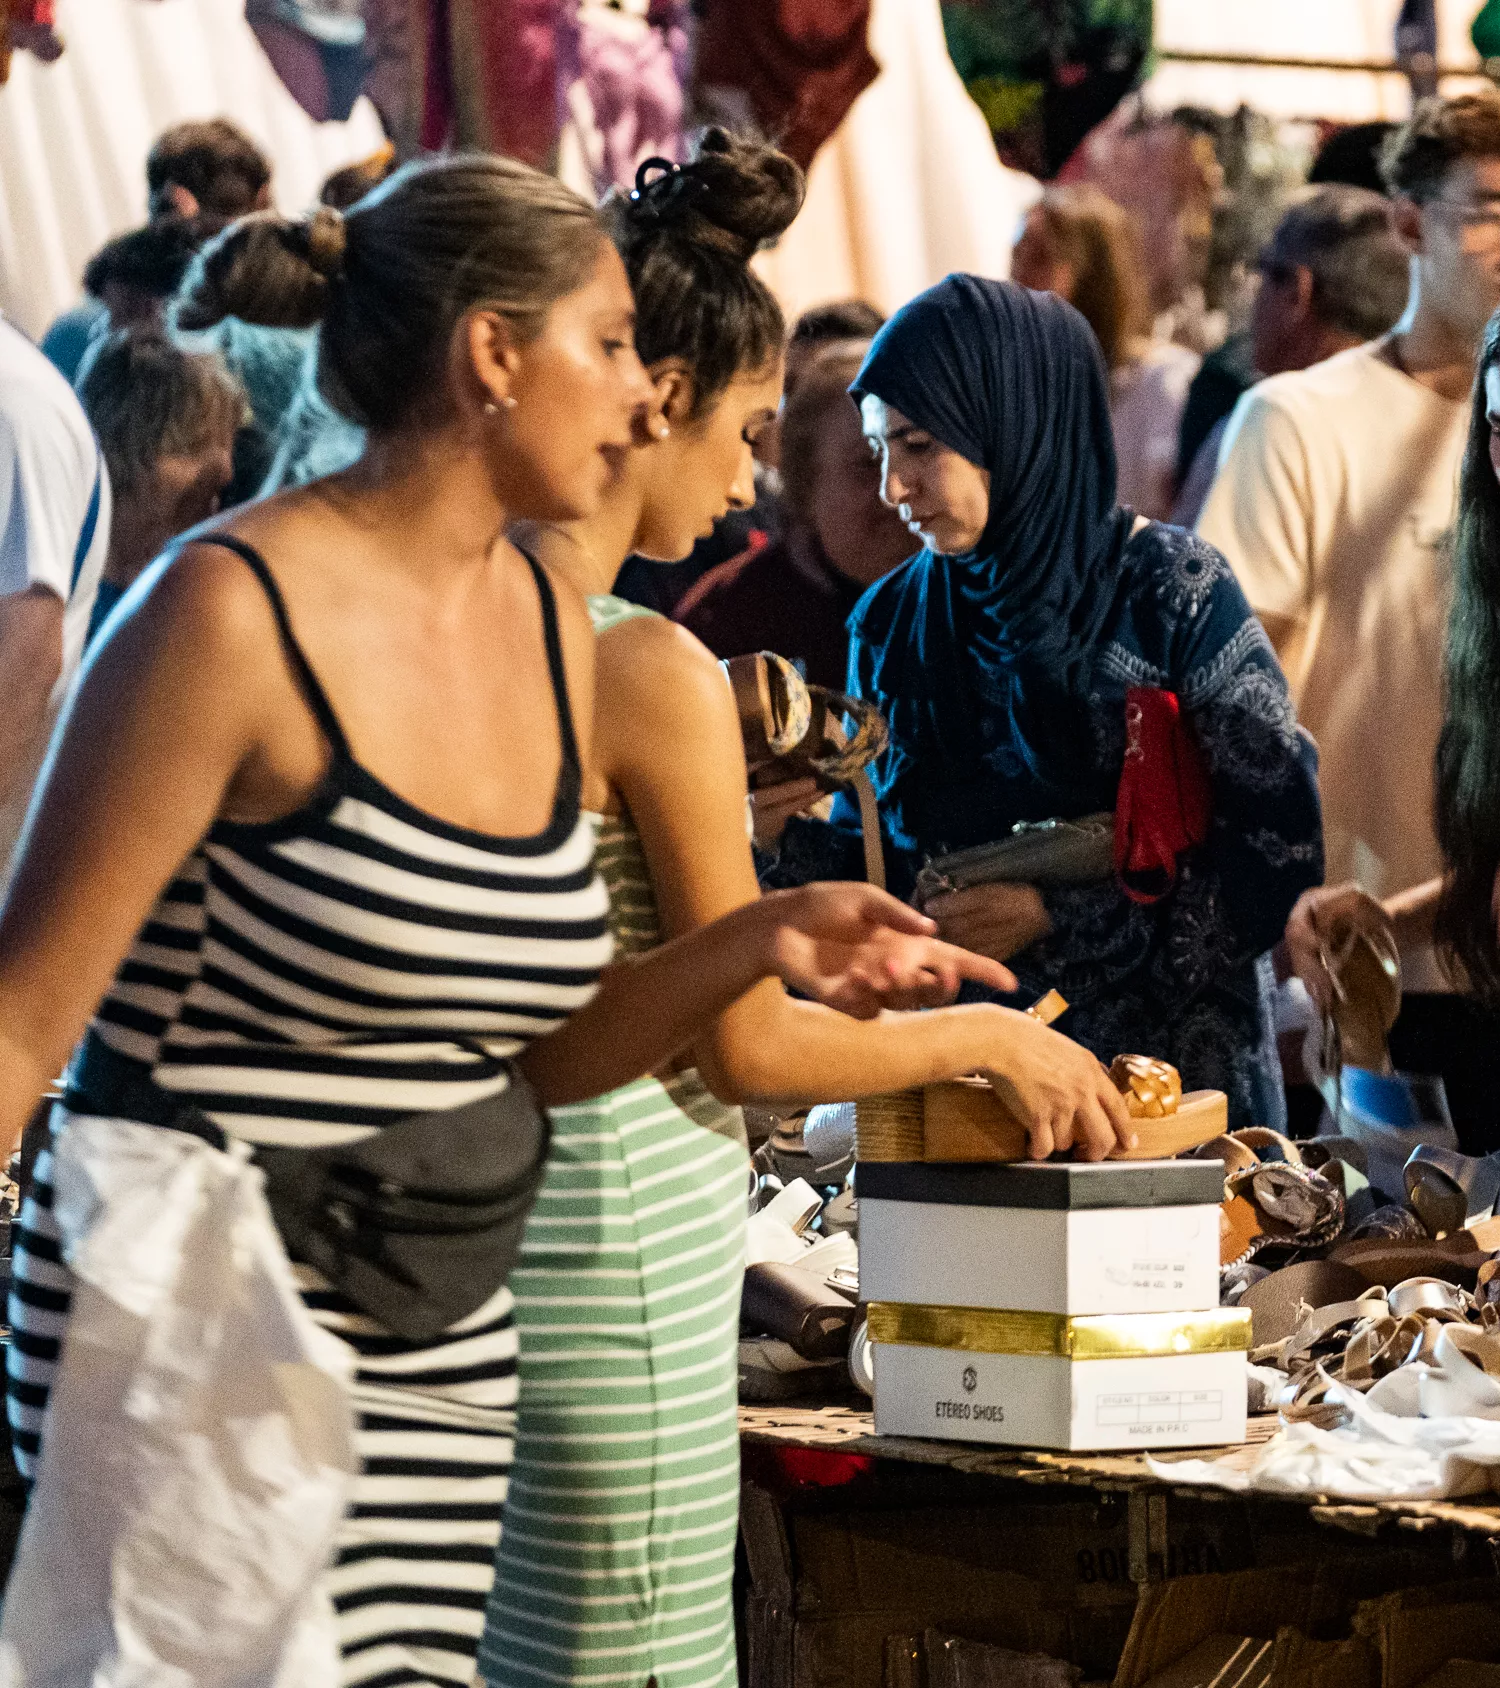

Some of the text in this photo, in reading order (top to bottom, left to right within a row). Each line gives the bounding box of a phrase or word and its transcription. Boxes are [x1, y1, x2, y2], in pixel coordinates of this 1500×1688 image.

[936, 1399, 1004, 1422] ETÉREO SHOES
[1129, 1426, 1153, 1434] MADE
[1156, 1425, 1165, 1433] IN
